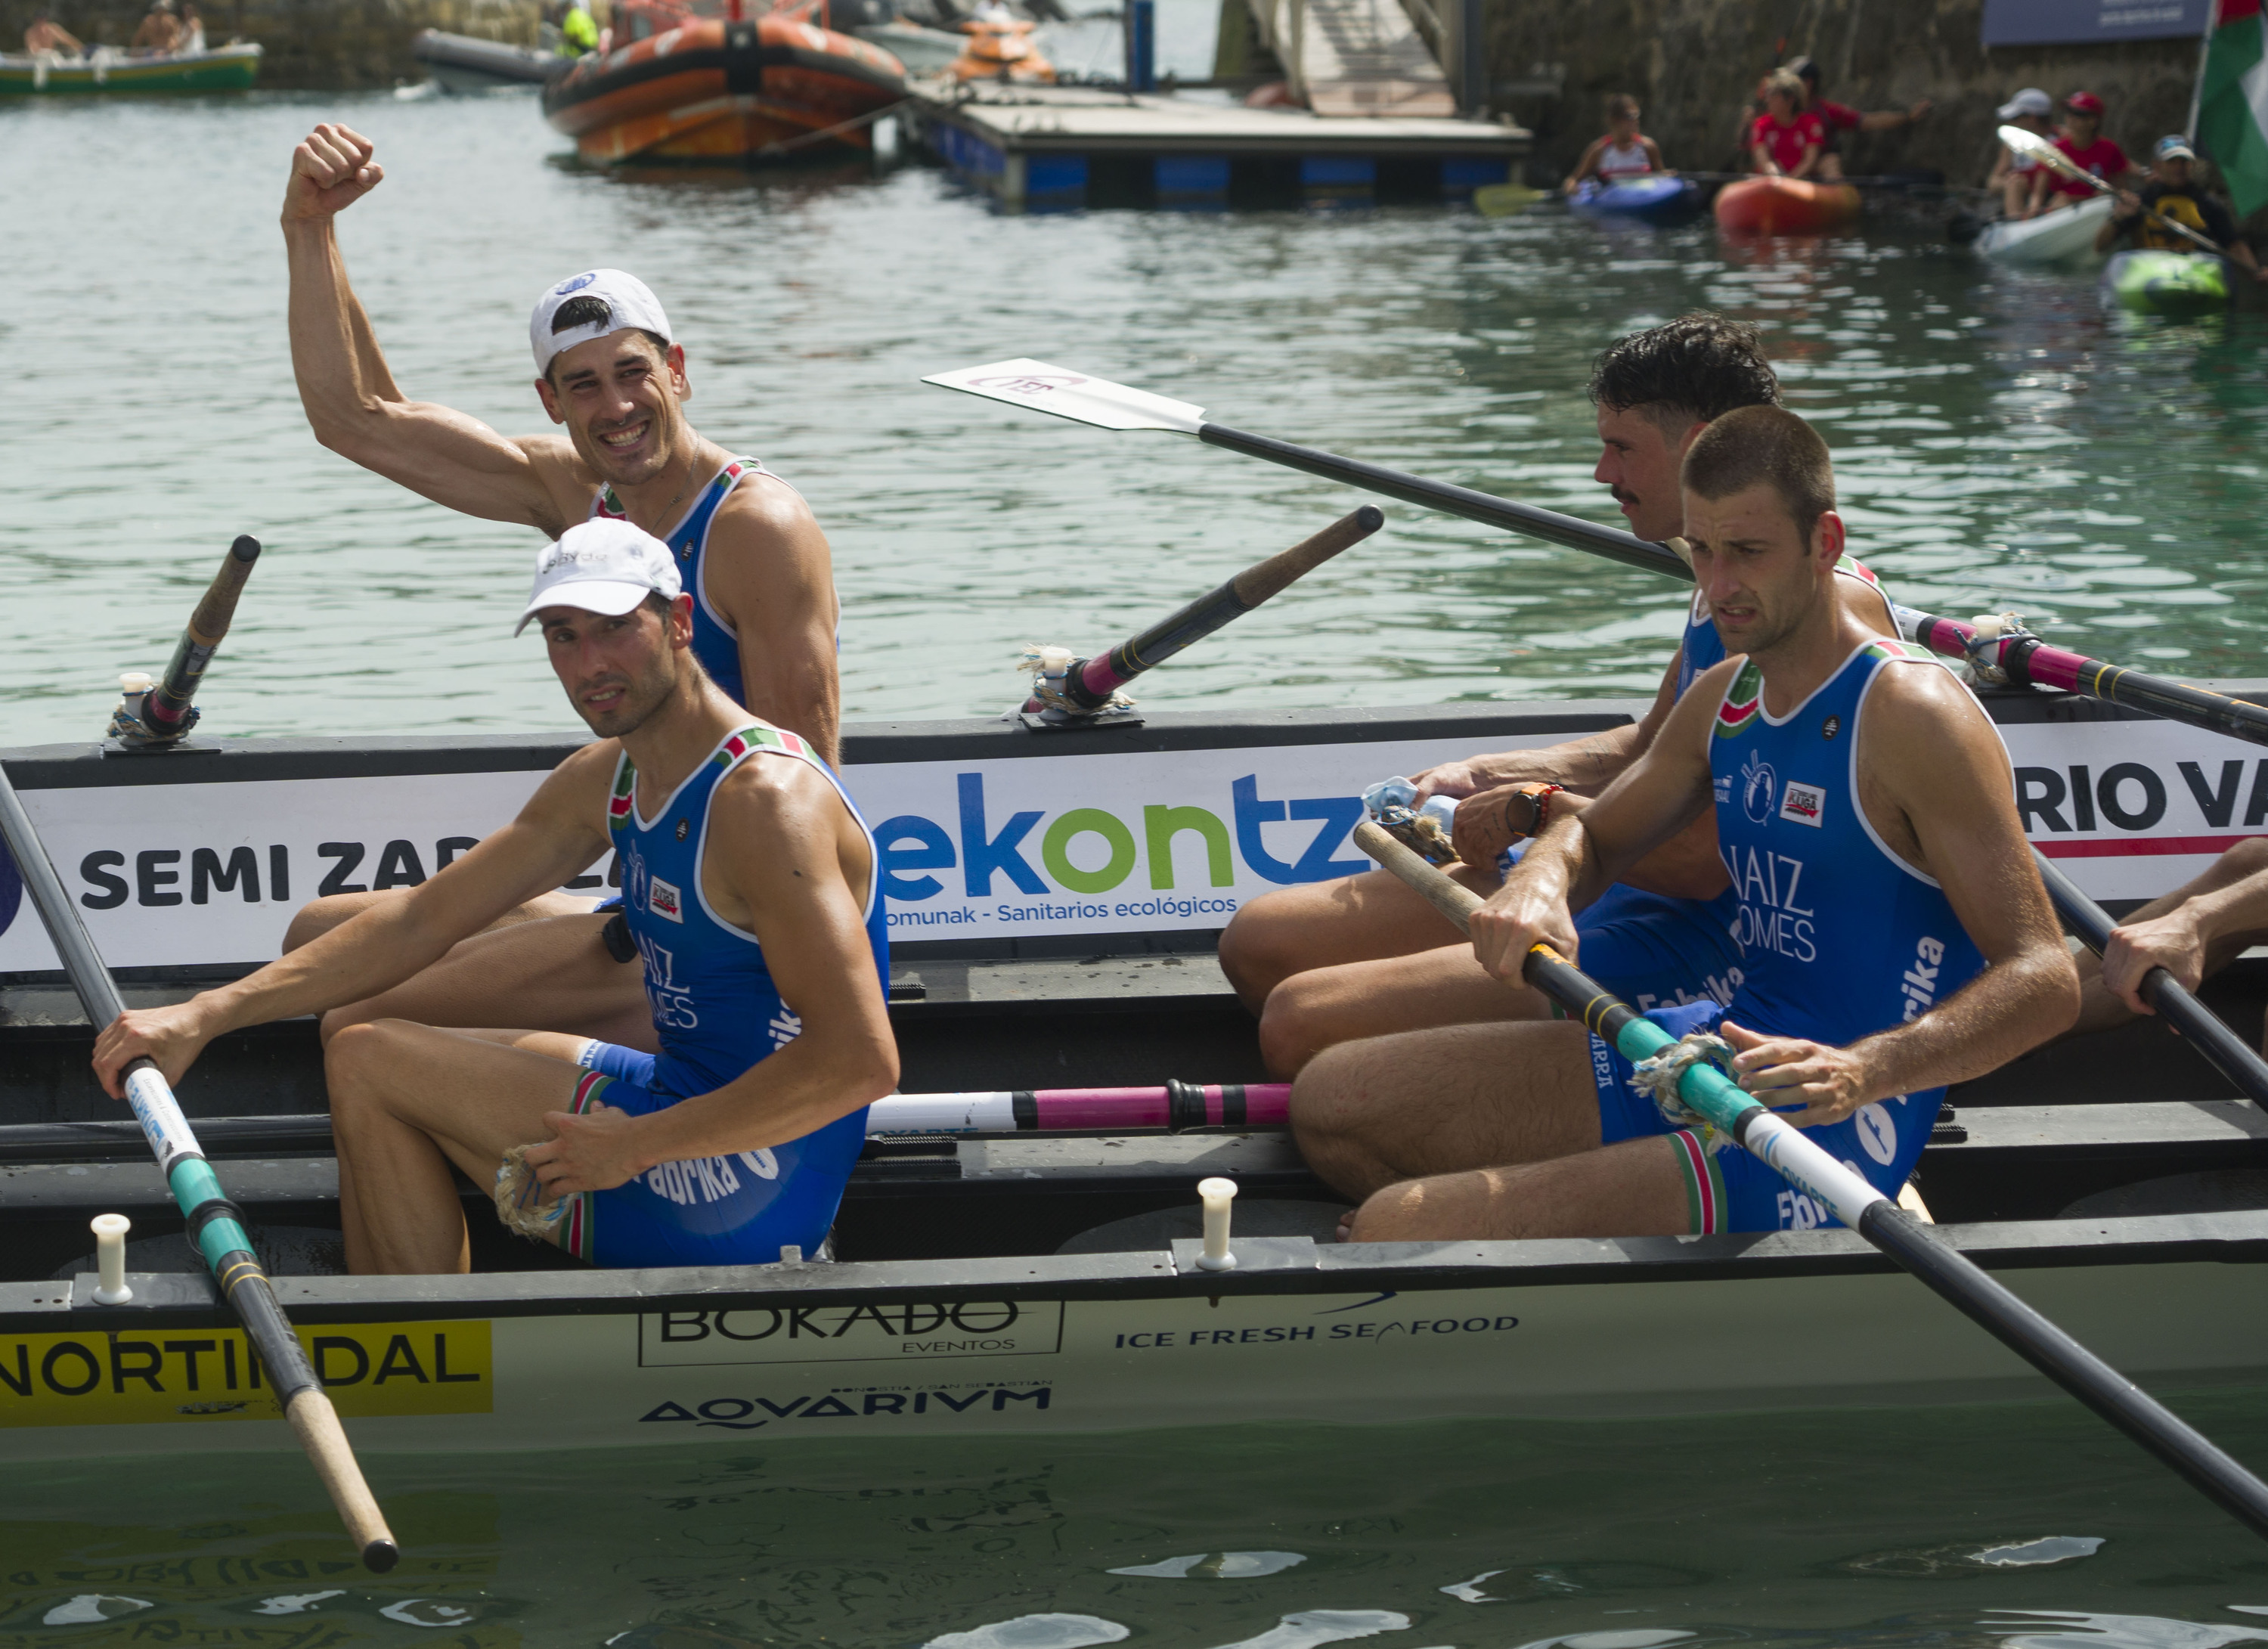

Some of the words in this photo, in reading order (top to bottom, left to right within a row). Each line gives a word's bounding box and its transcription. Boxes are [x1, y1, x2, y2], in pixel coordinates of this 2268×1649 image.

[2014, 762, 2168, 832] RIO
[873, 772, 1383, 901] ekontz
[80, 844, 290, 910] SEMI
[998, 900, 1108, 922] Sanitarios
[1115, 897, 1237, 918] ecológicos
[1738, 905, 1817, 962] OMES
[629, 929, 690, 993] AIZ
[1591, 1033, 1614, 1089] ARRA
[633, 1155, 741, 1205] abrika
[661, 1301, 1021, 1343] BOKADO
[902, 1338, 1016, 1354] EVENTOS
[1115, 1331, 1174, 1349] ICE
[1189, 1325, 1315, 1346] FRESH
[1329, 1316, 1520, 1345] SEAFOOD
[965, 1379, 1053, 1388] SEBASTIAN
